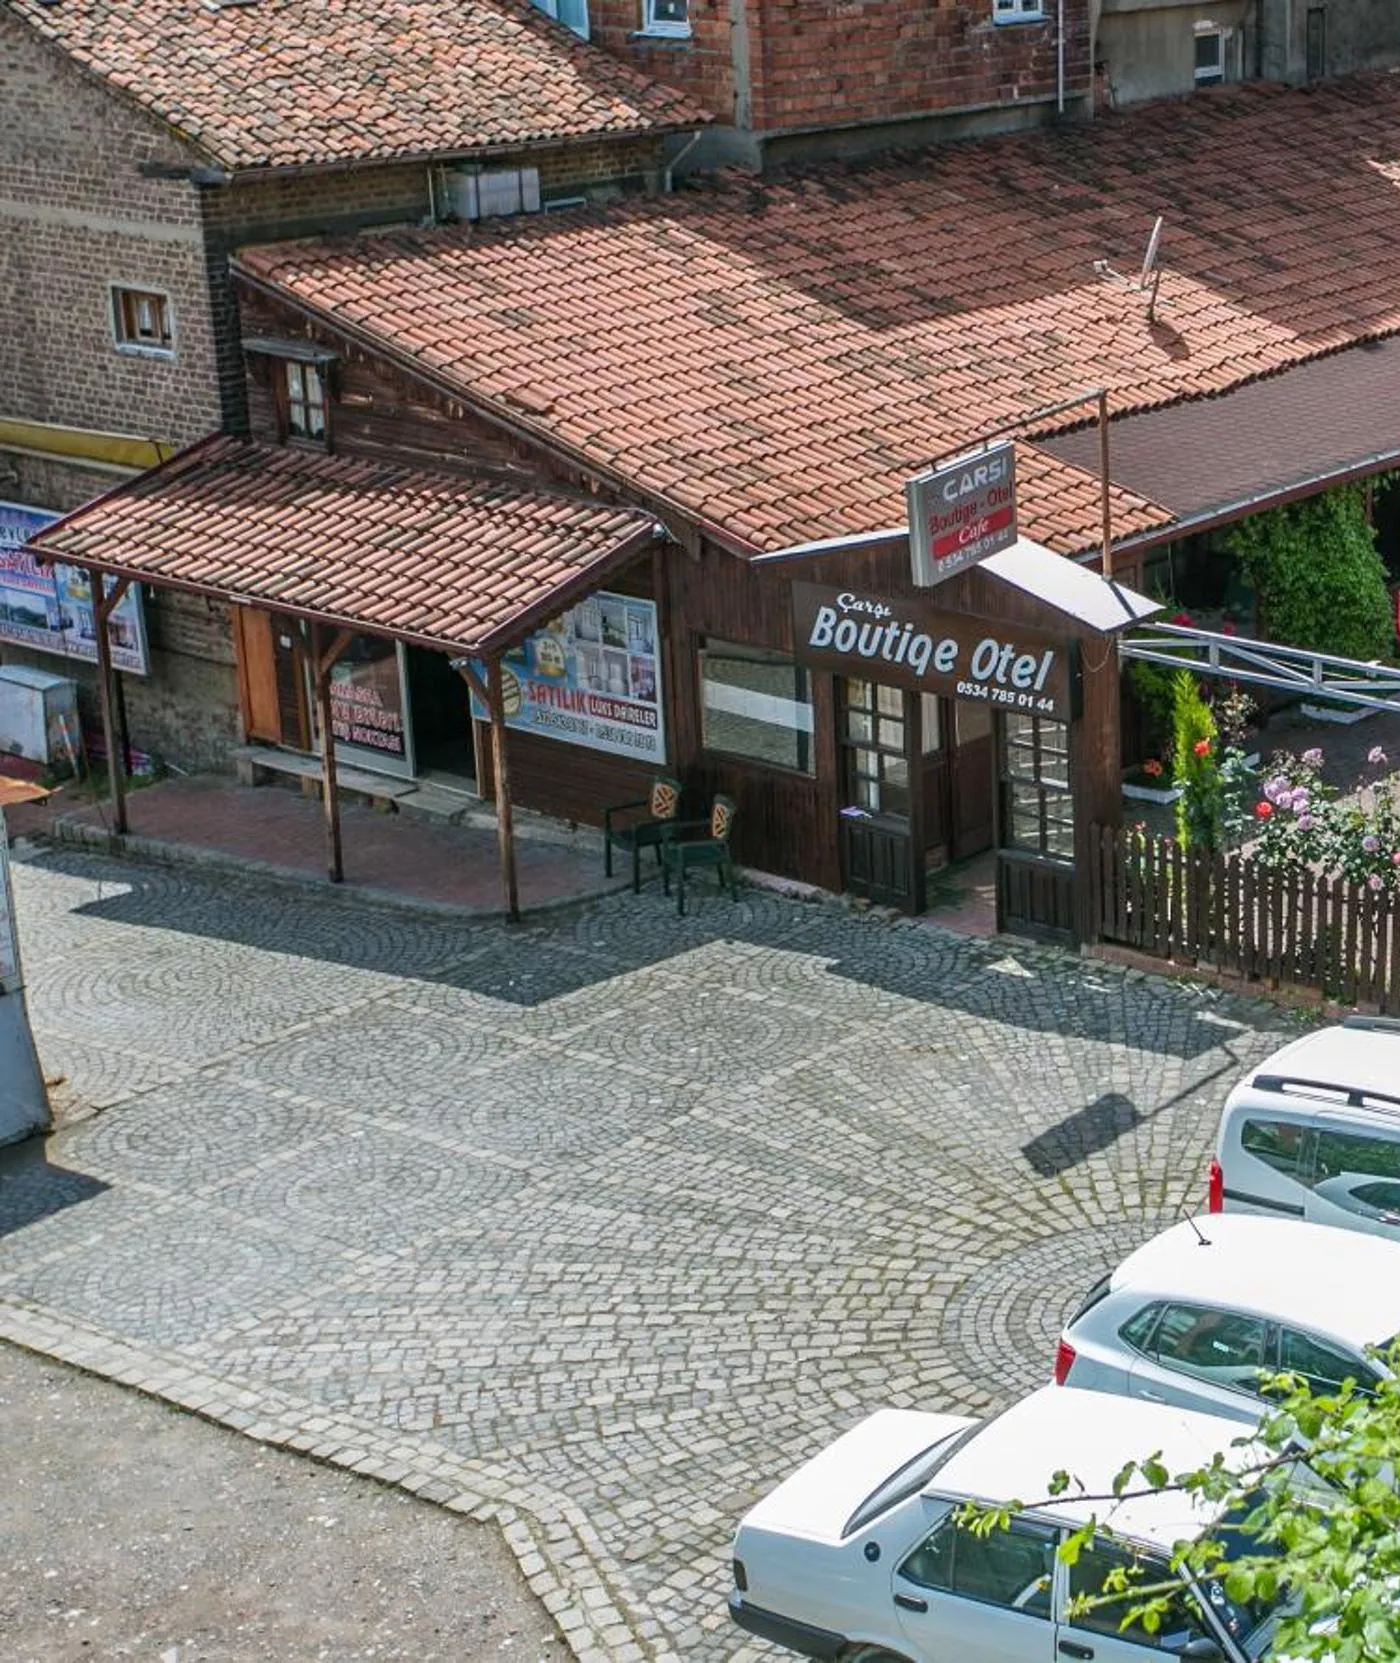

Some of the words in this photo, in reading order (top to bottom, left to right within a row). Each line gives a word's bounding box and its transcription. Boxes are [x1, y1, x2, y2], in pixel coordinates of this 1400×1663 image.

[958, 518, 989, 544] Cafe
[809, 606, 959, 676] Boutiqe
[971, 638, 1055, 691] Otel
[527, 680, 591, 715] SATILIK
[957, 681, 988, 698] 0534
[991, 687, 1015, 704] 785
[1018, 694, 1034, 709] 01
[1037, 698, 1055, 712] 44
